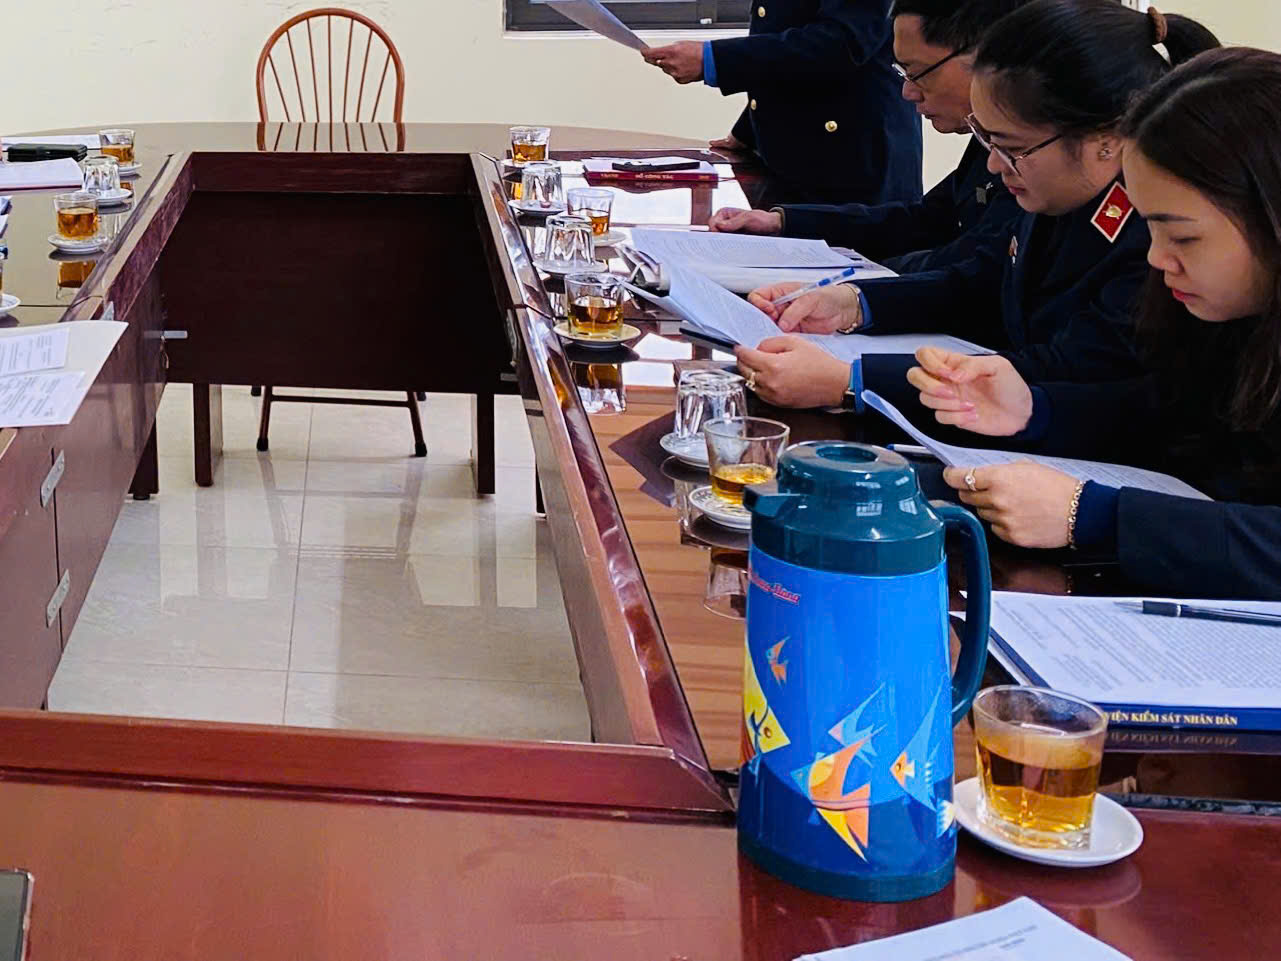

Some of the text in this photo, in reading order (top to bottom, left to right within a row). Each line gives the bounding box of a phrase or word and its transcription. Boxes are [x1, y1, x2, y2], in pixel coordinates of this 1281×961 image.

[1131, 709, 1159, 723] KIỂM
[1161, 711, 1180, 724] SÁT
[1183, 713, 1213, 725] NHÂN
[1215, 714, 1238, 726] DÂN
